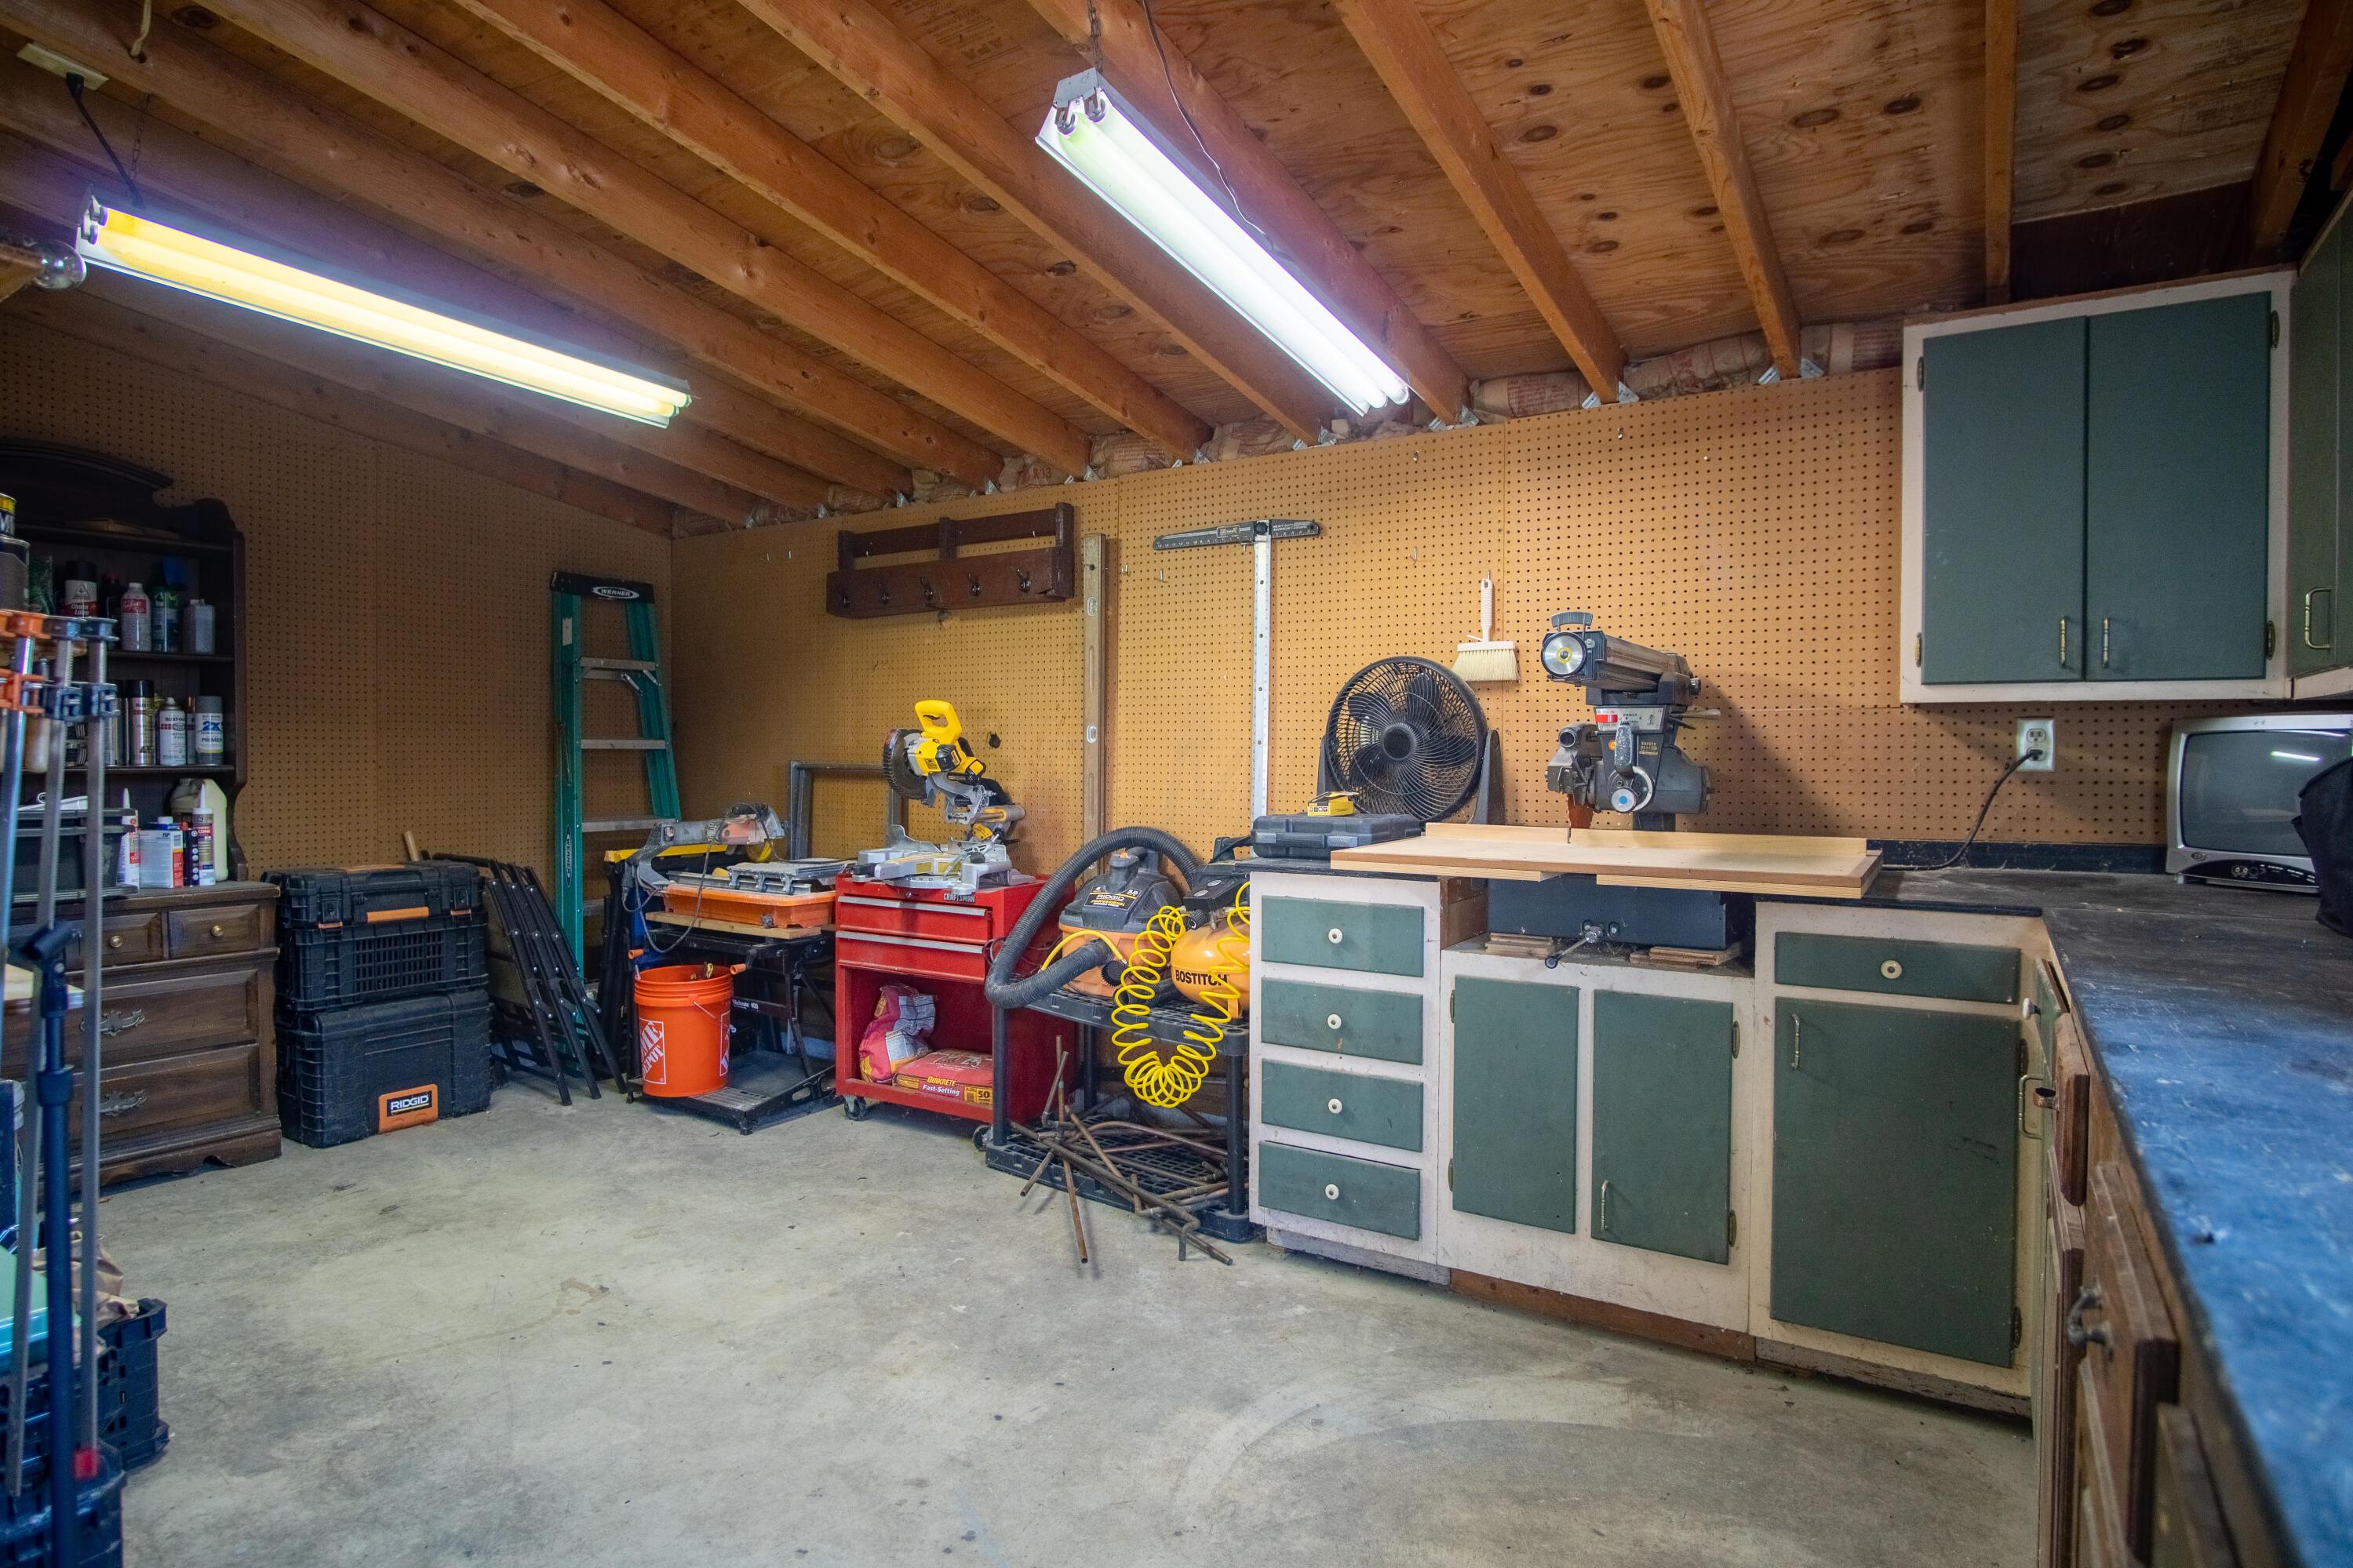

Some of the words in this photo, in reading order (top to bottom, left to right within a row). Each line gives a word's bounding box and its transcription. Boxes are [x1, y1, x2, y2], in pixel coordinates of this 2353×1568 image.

[601, 588, 631, 597] WERNER
[943, 893, 976, 903] CRAFTSMAN
[1175, 970, 1229, 986] BOSTITCH
[927, 1075, 957, 1087] QUIKRETE
[922, 1084, 960, 1097] Fast-Setting
[978, 1090, 991, 1099] 50
[390, 1095, 429, 1111] RIDGID
